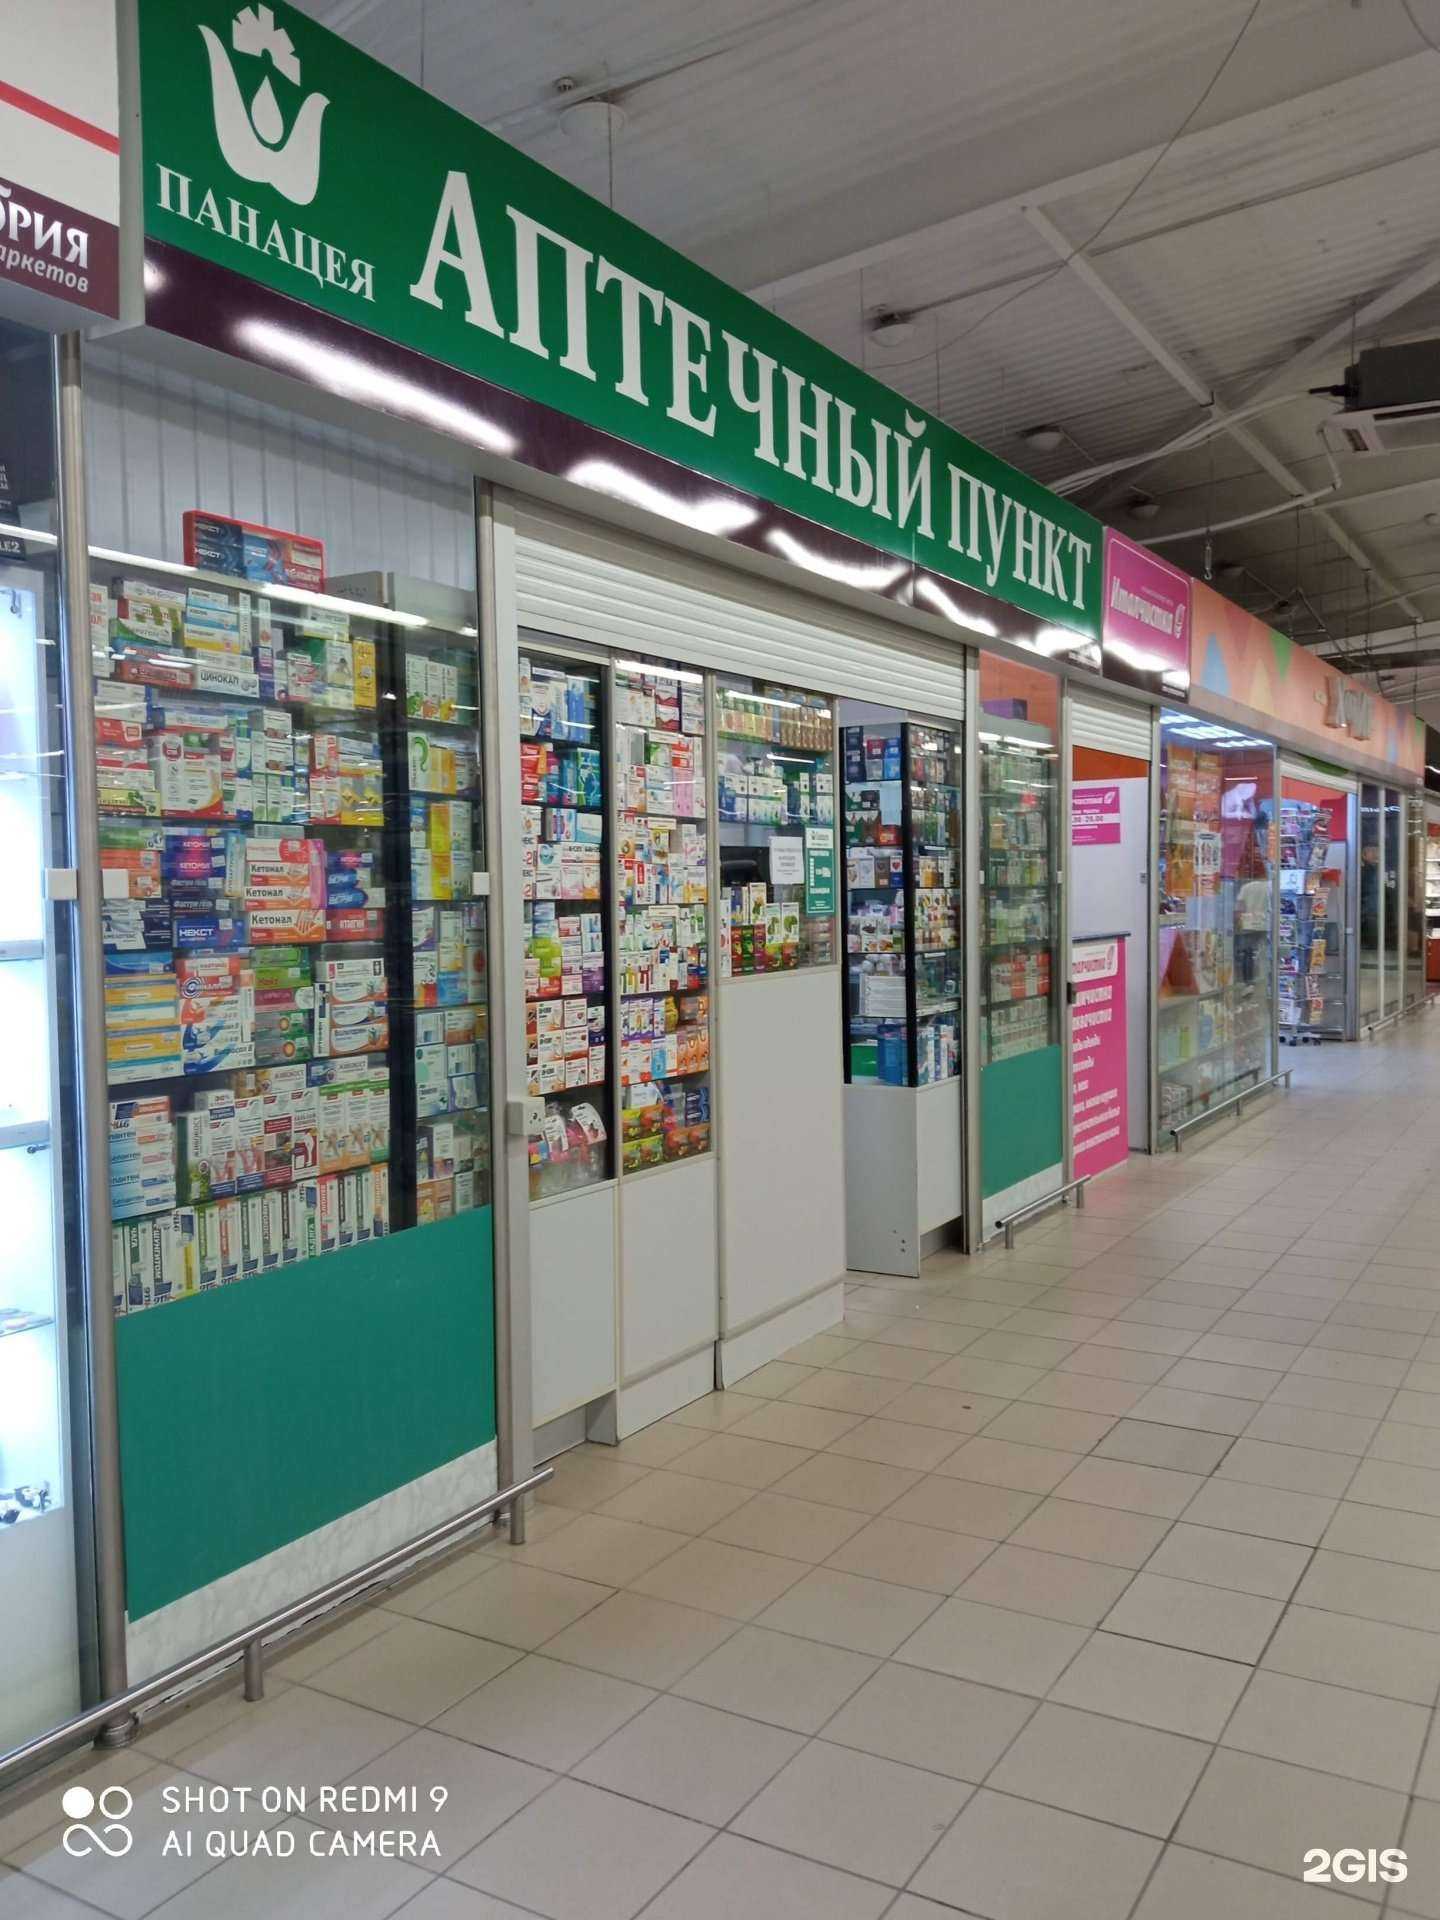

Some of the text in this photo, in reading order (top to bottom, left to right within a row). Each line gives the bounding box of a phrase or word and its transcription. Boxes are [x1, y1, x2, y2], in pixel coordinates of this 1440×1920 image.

[156, 163, 376, 302] ПАНАЦЕЯ
[409, 170, 1091, 610] АПТЕЧНЫЙ ПУНКТ
[200, 672, 240, 686] ЦИНОКАП
[250, 864, 285, 874] Кетонал
[245, 887, 284, 897] Кетонал
[251, 912, 292, 924] Кетонал
[179, 928, 214, 937] НЕКСТ
